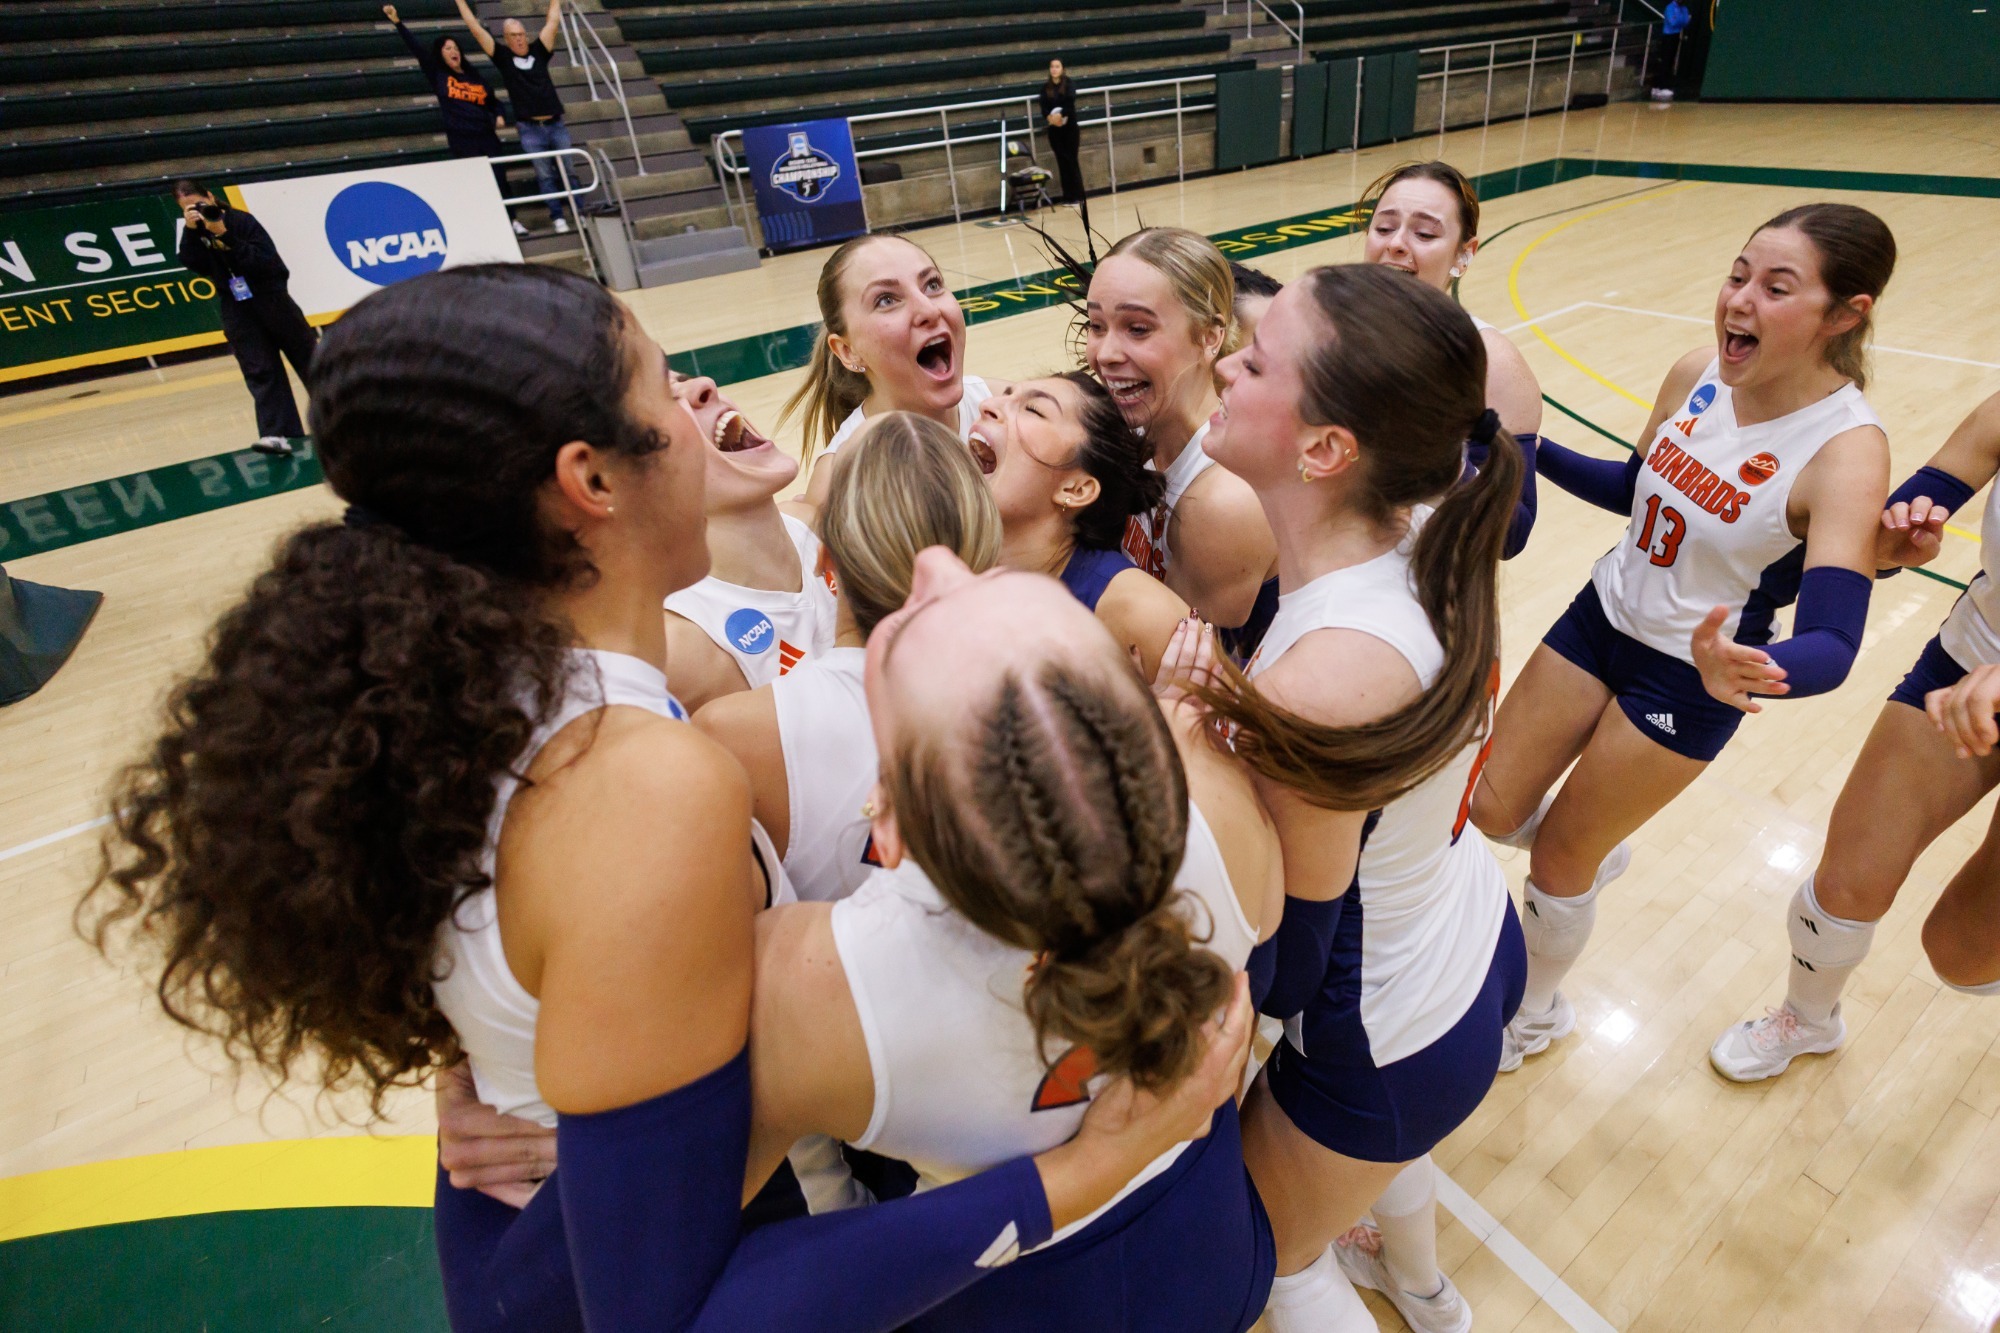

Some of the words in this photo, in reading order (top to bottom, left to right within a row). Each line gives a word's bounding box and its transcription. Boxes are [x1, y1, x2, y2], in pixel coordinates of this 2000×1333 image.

[772, 165, 838, 185] CHAMPIONSHIP
[345, 228, 448, 269] NCAA
[0, 298, 73, 331] ENT
[86, 277, 216, 317] SECTIO
[1646, 436, 1751, 524] SUNBIRDS
[1635, 492, 1687, 568] 13
[737, 619, 772, 649] NCAA
[1645, 713, 1677, 735] adidas
